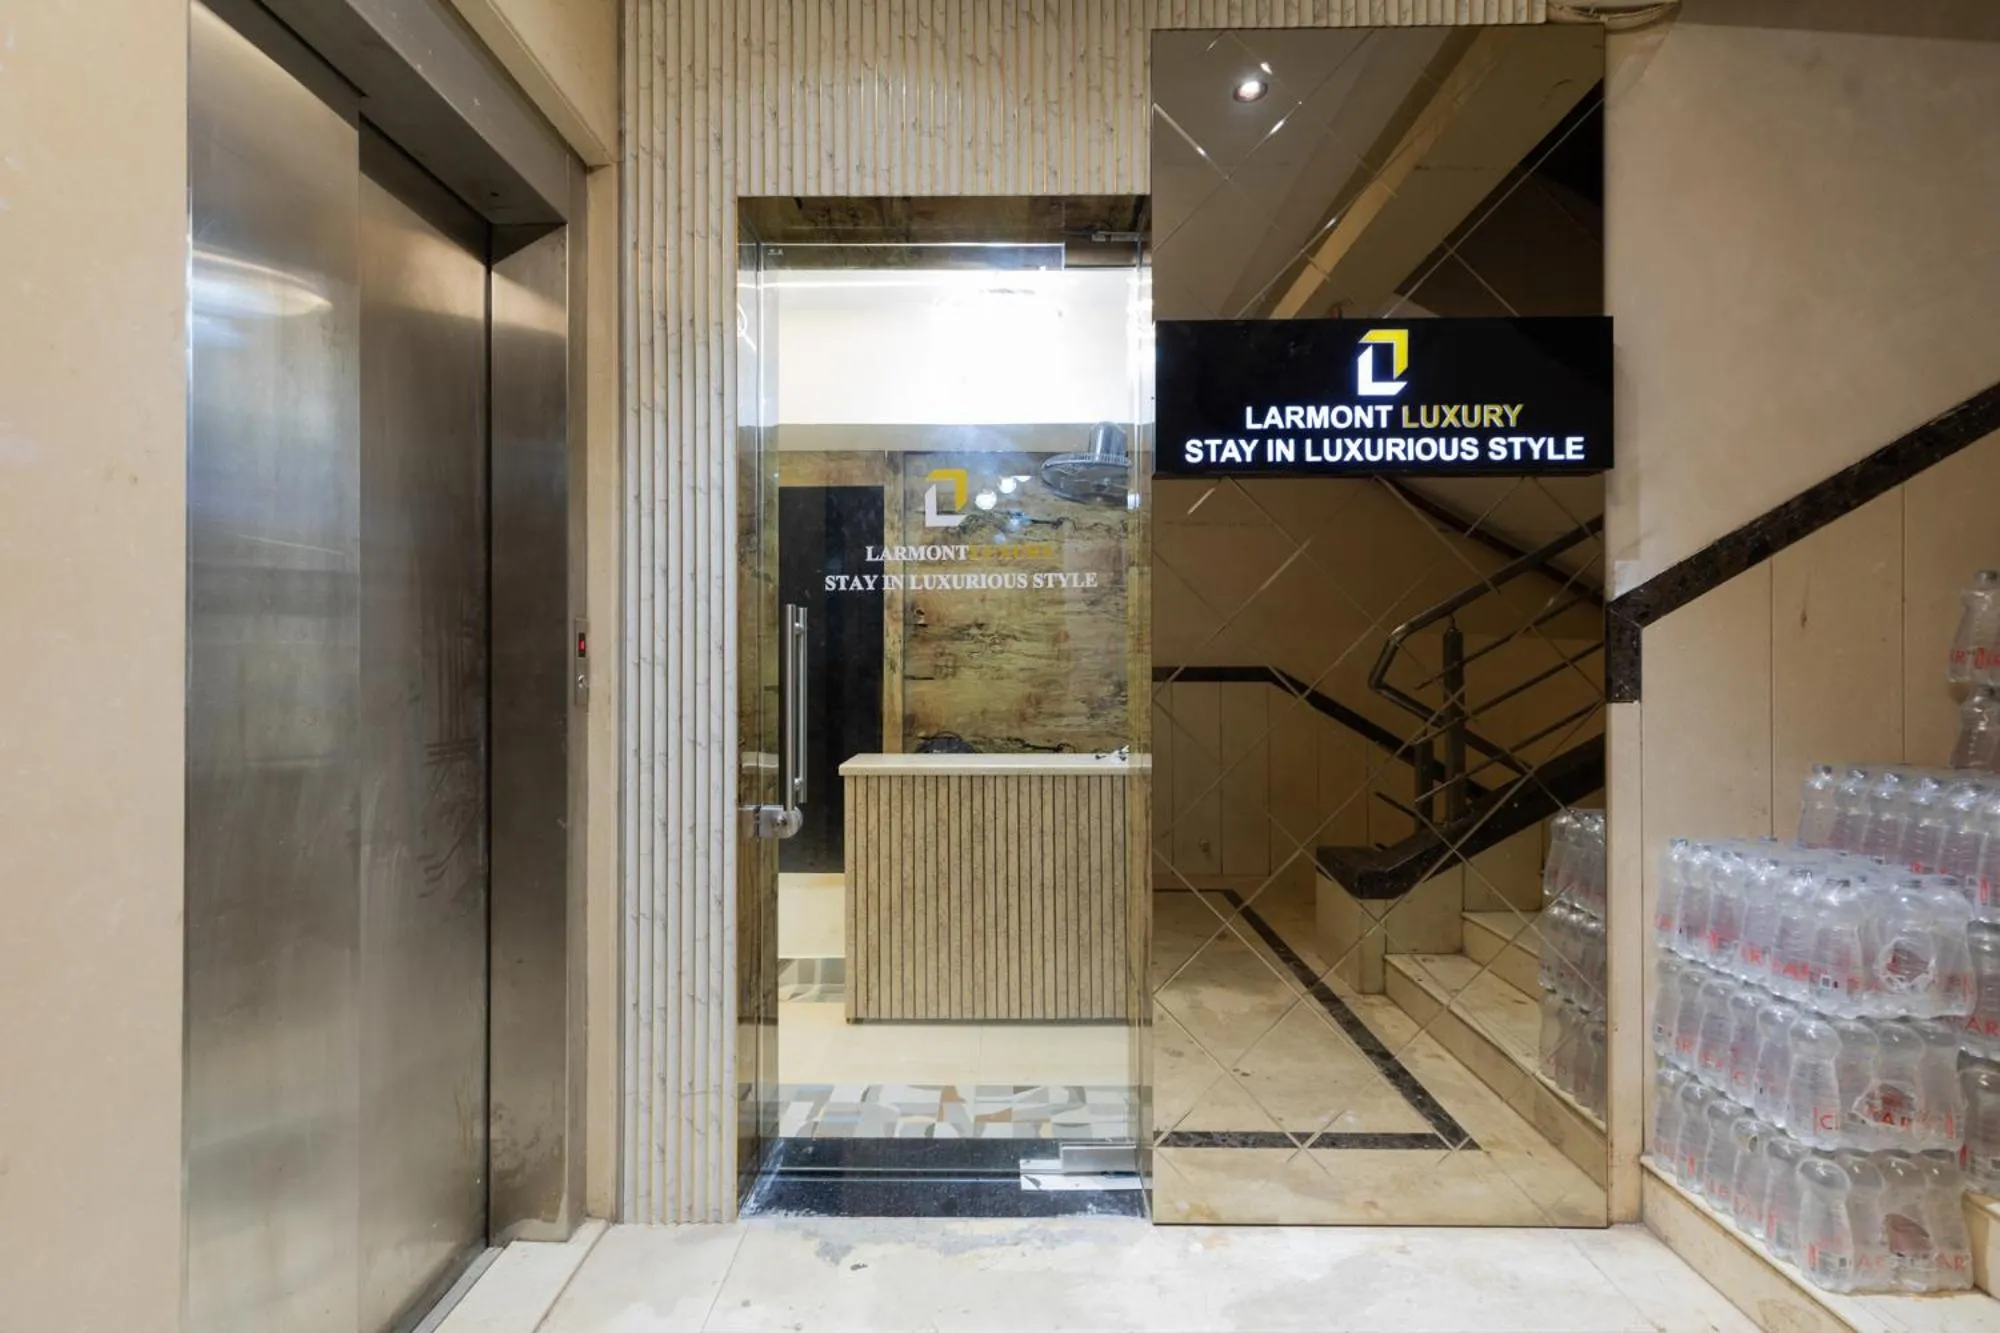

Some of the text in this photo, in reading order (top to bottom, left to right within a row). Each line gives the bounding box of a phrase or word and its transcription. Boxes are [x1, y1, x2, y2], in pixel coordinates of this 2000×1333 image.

[1245, 404, 1524, 430] LARMONT LUXURY
[1184, 436, 1585, 463] STAY IN LUXURIOUS STYLE
[865, 545, 969, 562] LARMONT
[824, 571, 1098, 592] STAY IN LUXURIOUS STYLE
